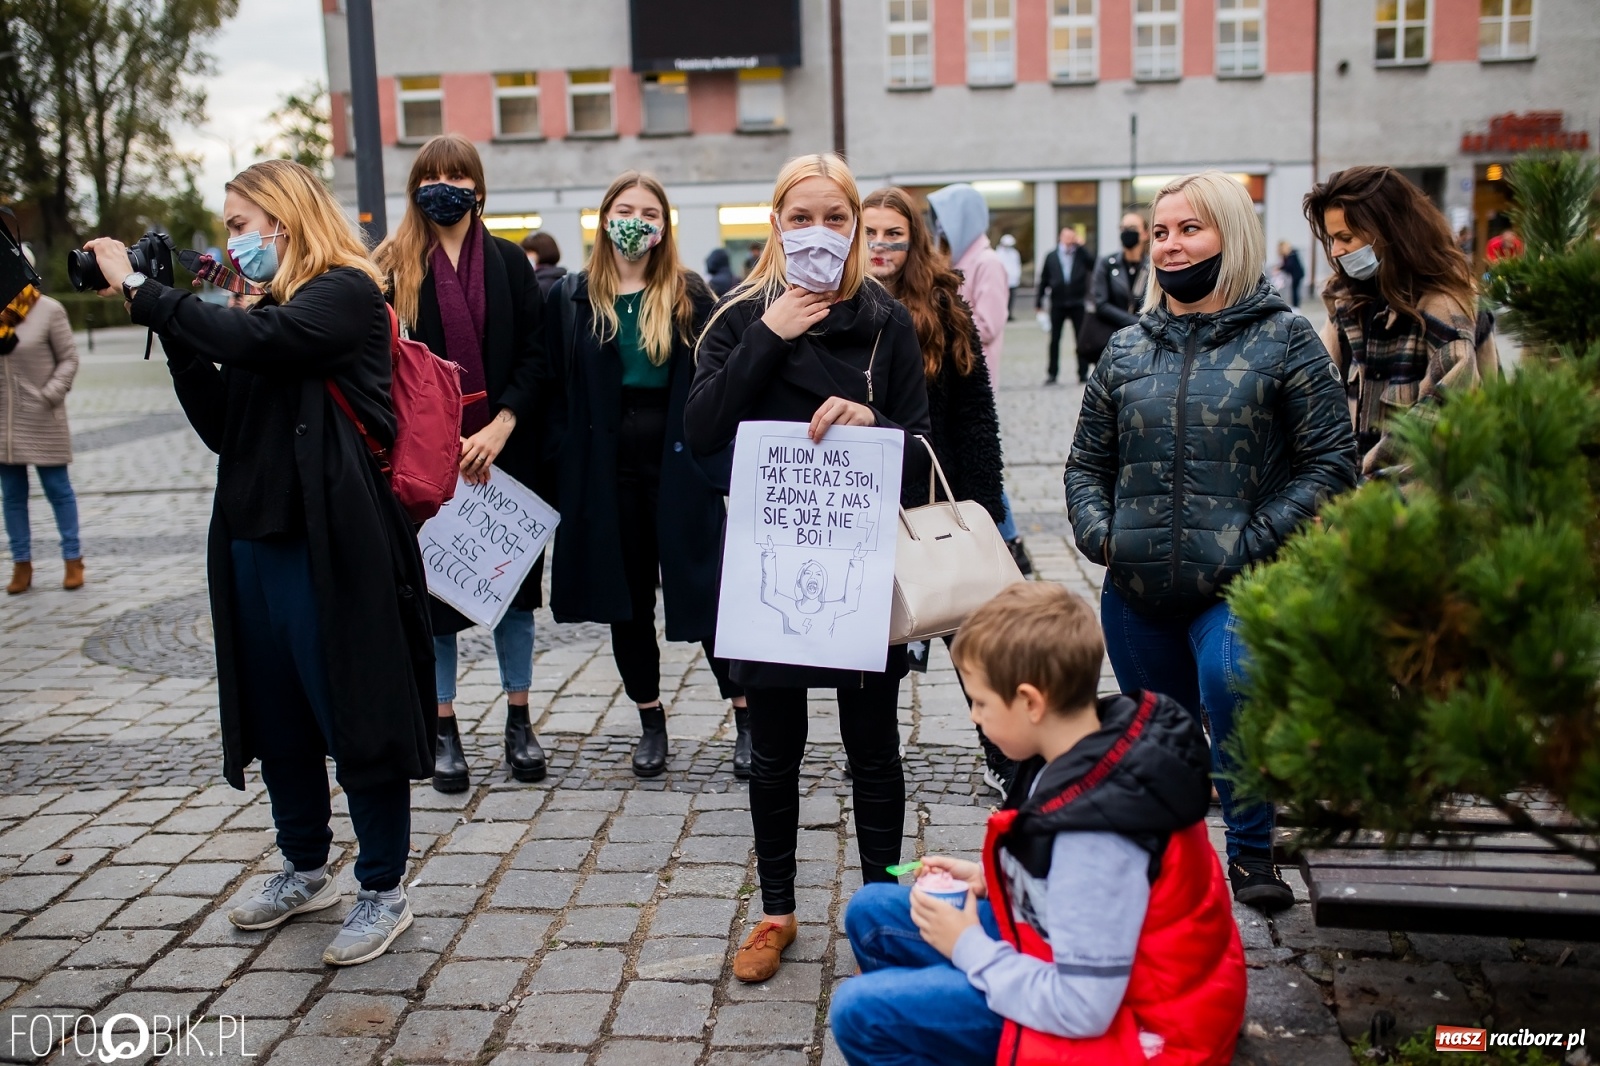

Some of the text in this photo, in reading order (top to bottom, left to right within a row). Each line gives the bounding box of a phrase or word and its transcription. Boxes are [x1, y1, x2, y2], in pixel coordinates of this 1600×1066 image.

[768, 446, 850, 467] MILION NAS
[760, 465, 787, 484] TAK
[792, 468, 841, 487] TERAZ
[826, 492, 835, 507] Z
[841, 493, 871, 509] NAS
[458, 498, 530, 560] ABORCJA
[517, 509, 547, 540] BEZ
[763, 507, 789, 529] SIĘ
[827, 511, 854, 529] NIE
[451, 533, 486, 562] 597
[473, 578, 503, 604] +48
